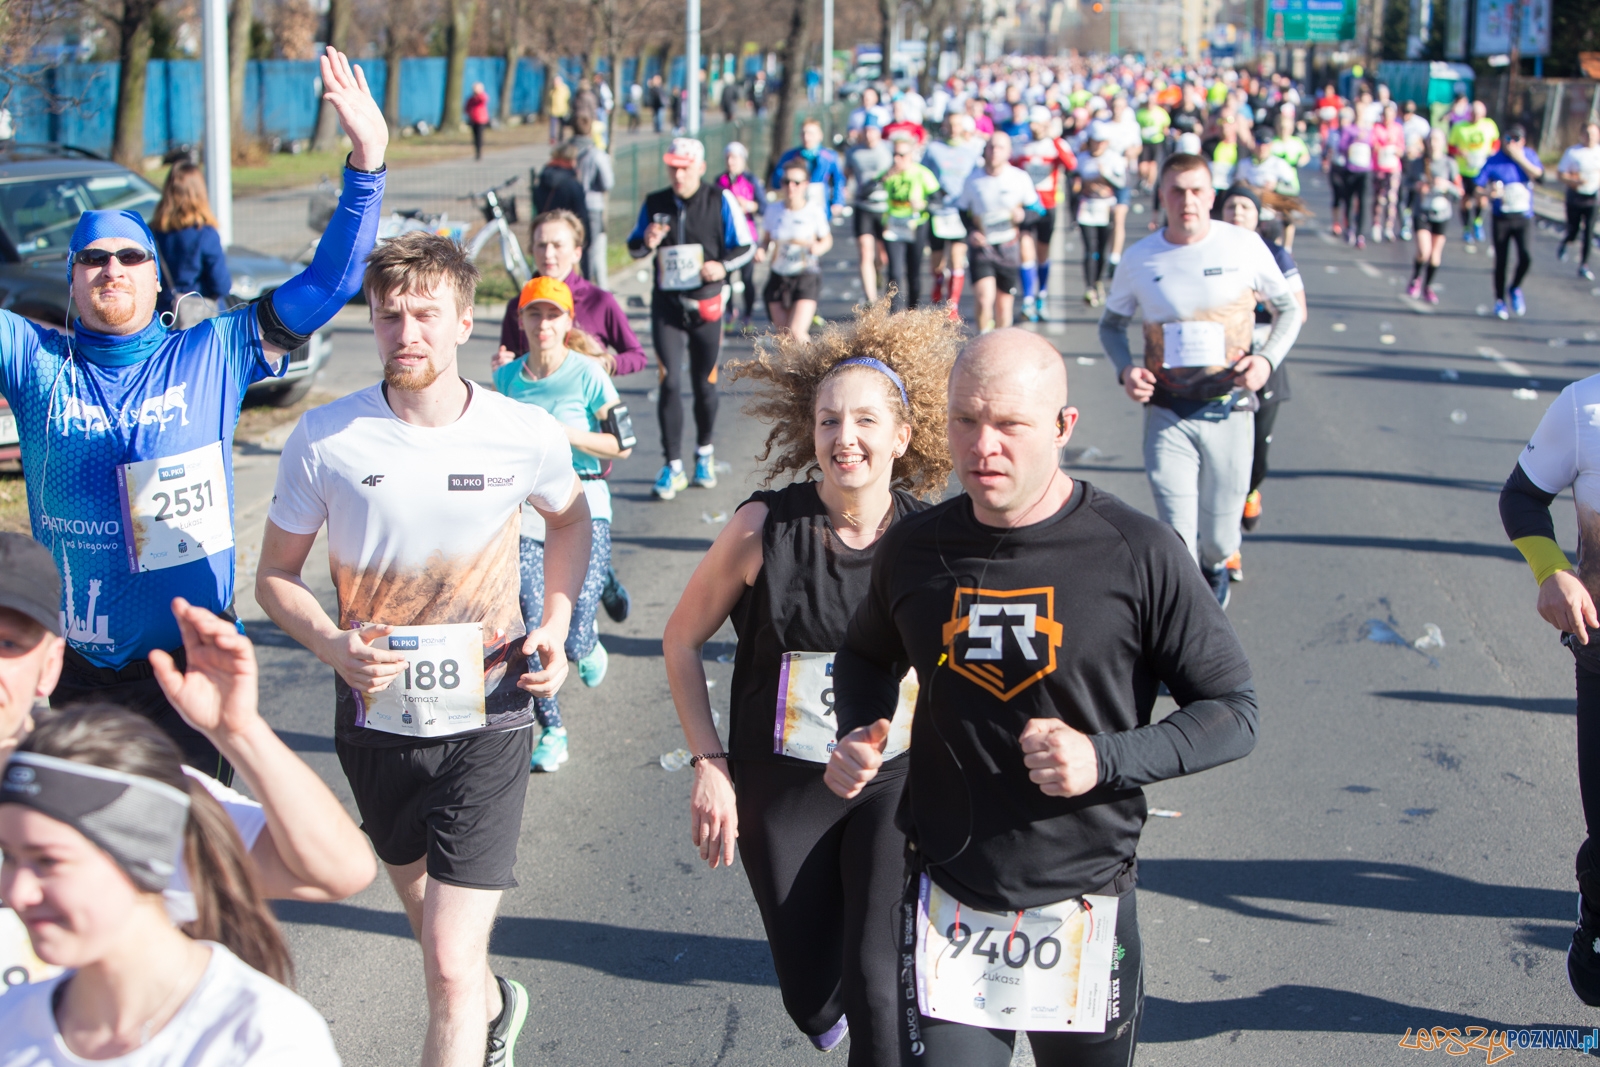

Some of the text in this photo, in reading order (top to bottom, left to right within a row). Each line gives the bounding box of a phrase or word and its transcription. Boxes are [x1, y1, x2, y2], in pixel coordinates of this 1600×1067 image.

[170, 468, 184, 477] PKO
[451, 478, 482, 487] 10. PKO
[152, 479, 214, 522] 2531
[78, 540, 119, 554] biegowo
[391, 639, 401, 647] 10.
[401, 639, 417, 647] PKO
[402, 694, 439, 703] Tomasz
[946, 922, 1062, 970] 9400
